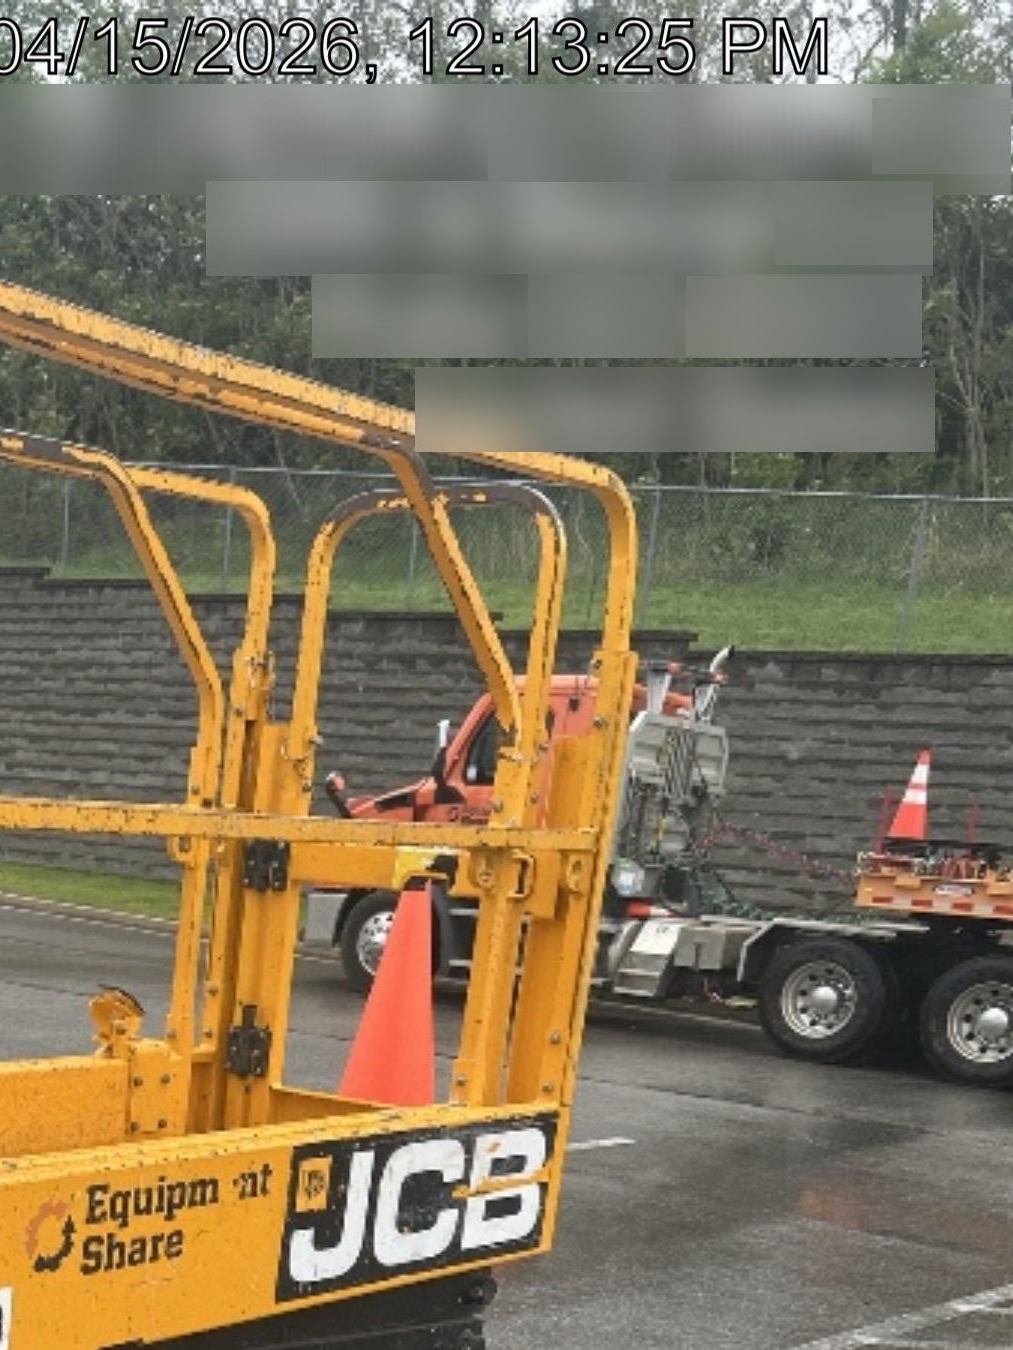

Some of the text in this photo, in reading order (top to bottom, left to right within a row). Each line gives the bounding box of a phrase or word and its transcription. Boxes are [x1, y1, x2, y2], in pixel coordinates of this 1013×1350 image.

[85, 1163, 273, 1229] Equipmnt
[290, 1128, 546, 1282] JCB
[80, 1228, 183, 1275] Share
